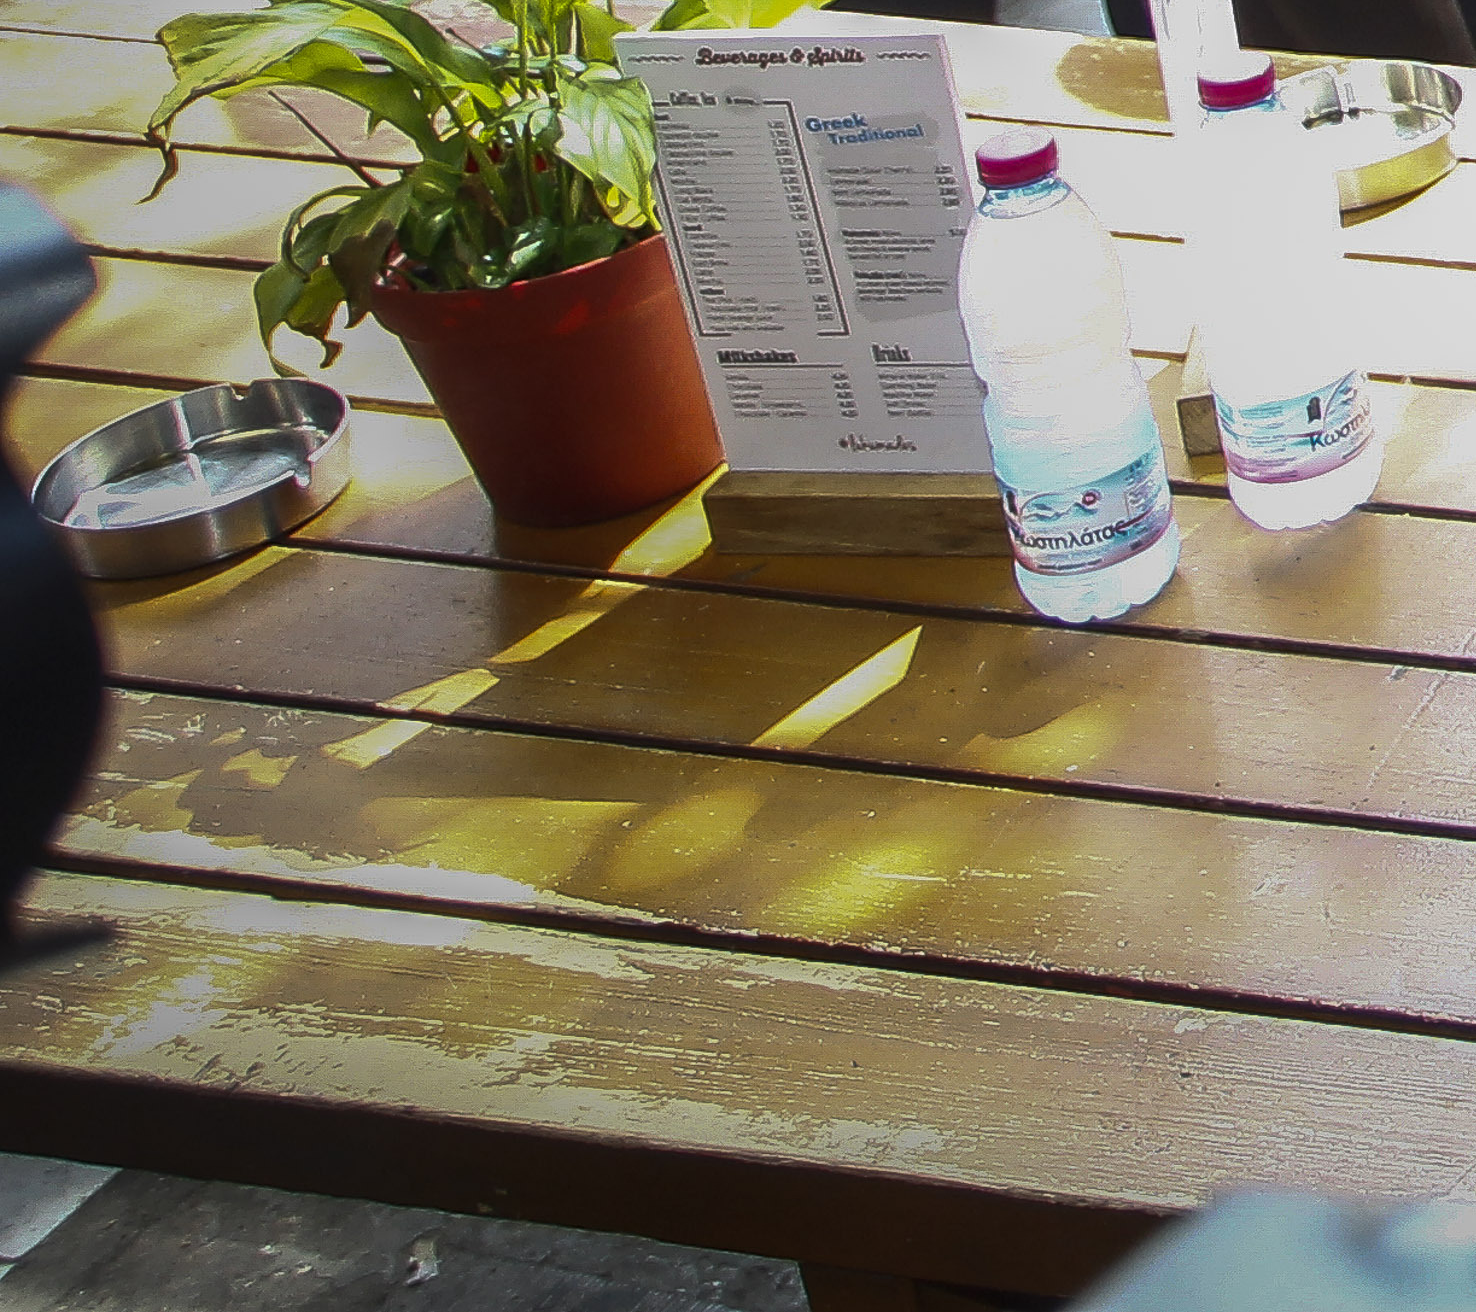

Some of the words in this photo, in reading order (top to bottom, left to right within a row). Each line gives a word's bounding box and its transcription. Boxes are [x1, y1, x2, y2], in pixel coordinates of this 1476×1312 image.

[696, 47, 787, 69] Beverages
[790, 47, 805, 64] &
[807, 45, 866, 67] Spirits
[805, 113, 867, 132] Greek
[828, 124, 925, 144] Traditional
